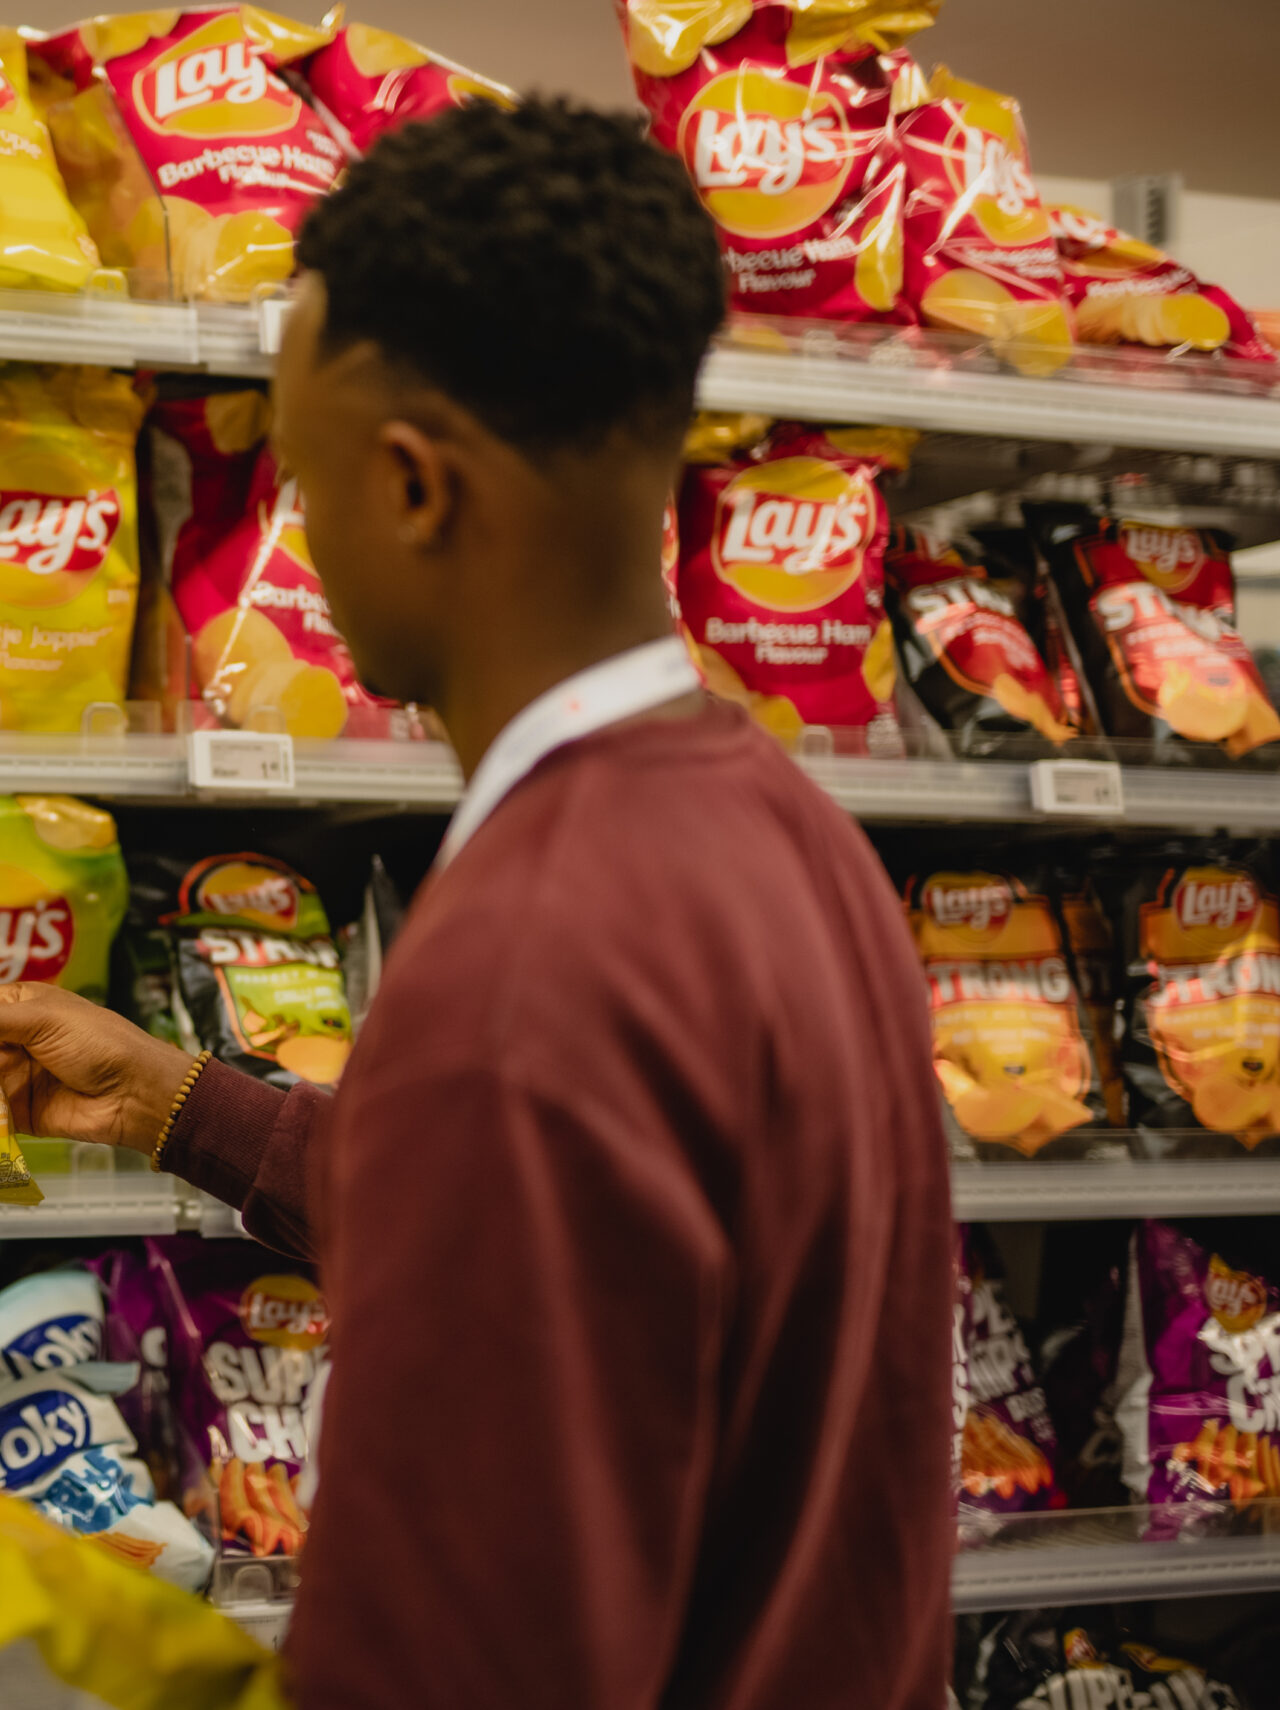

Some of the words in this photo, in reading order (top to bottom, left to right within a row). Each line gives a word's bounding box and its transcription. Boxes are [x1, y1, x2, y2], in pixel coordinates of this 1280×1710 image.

[155, 43, 289, 118] Lay
[157, 145, 282, 188] Barbecue
[723, 246, 805, 273] becue
[721, 488, 868, 575] Lay's
[821, 618, 871, 646] Ham
[1181, 878, 1256, 929] Lay's
[926, 957, 1070, 1003] TRONG
